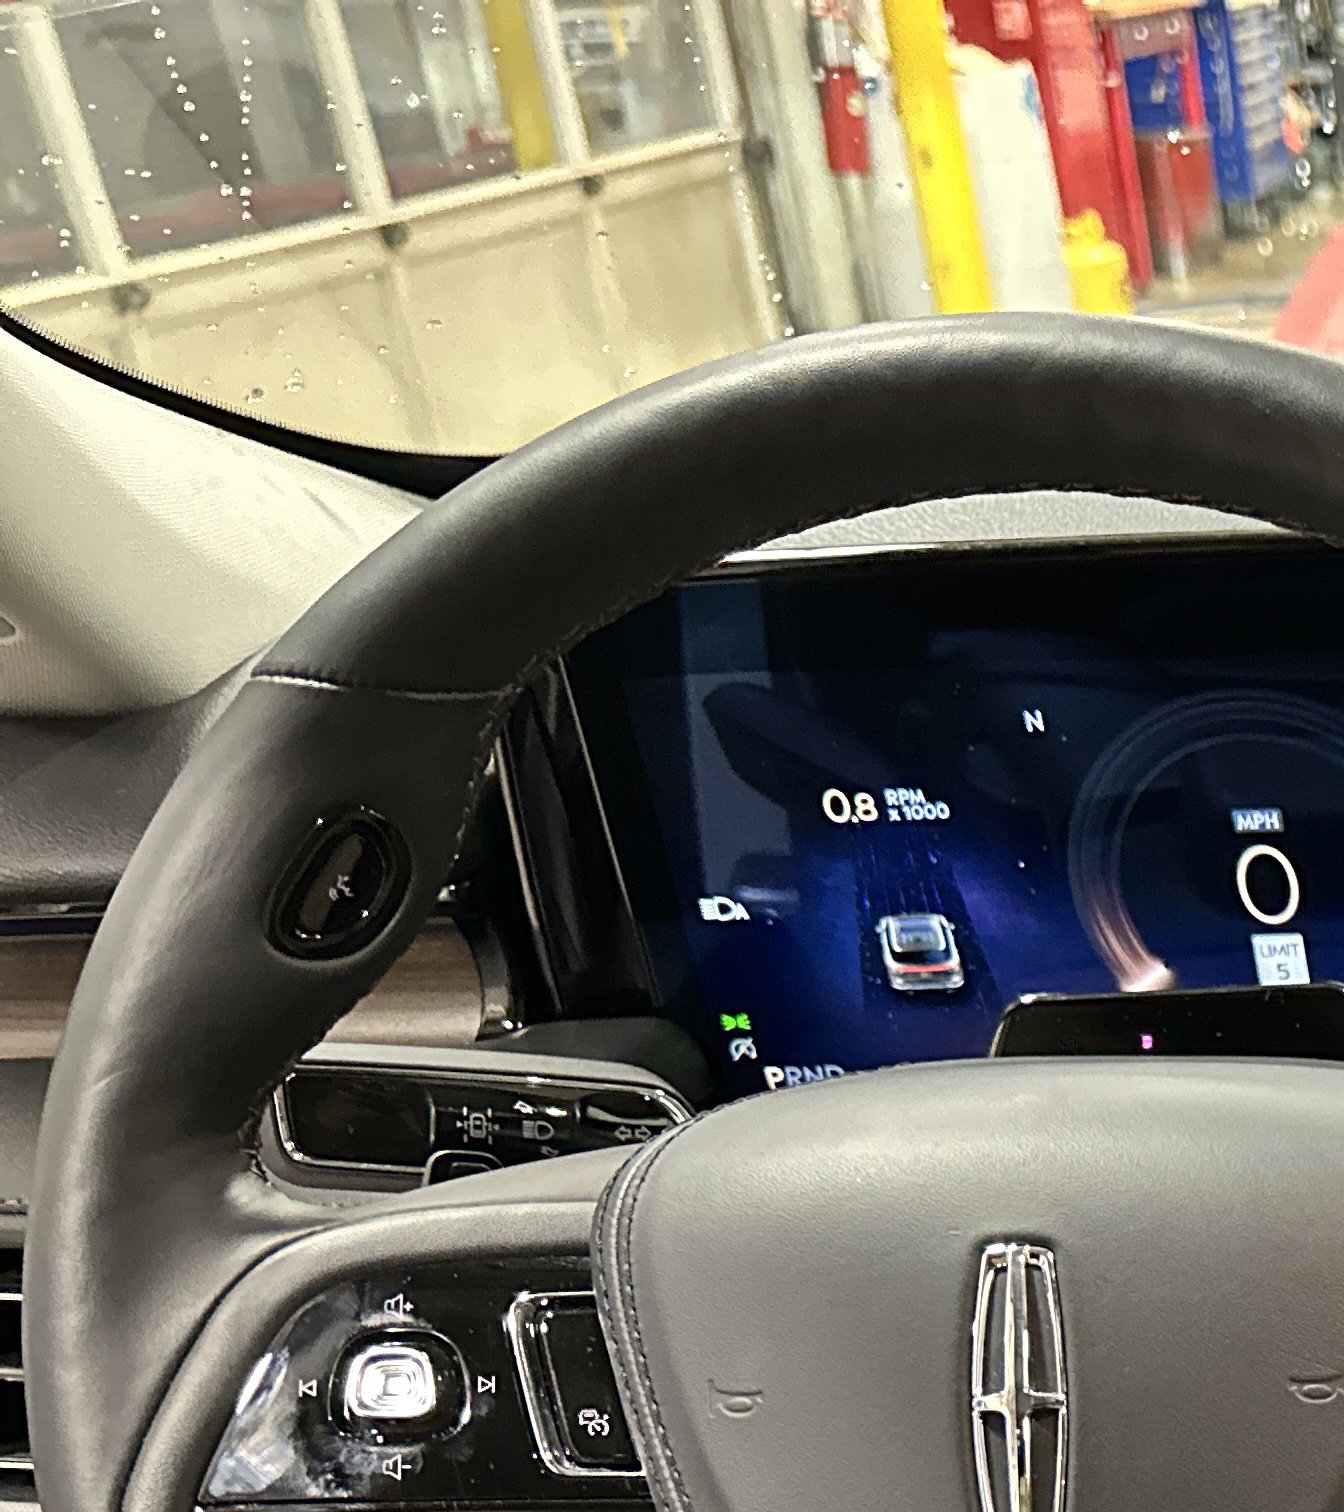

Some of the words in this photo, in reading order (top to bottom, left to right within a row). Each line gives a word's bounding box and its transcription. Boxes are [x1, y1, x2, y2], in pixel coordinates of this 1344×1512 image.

[1022, 709, 1046, 735] N
[822, 788, 879, 824] 0.8
[883, 787, 927, 806] RPM
[1235, 810, 1281, 833] MPH
[1236, 844, 1300, 925] 0
[1257, 941, 1301, 962] LIMIT
[1275, 961, 1290, 981] 5
